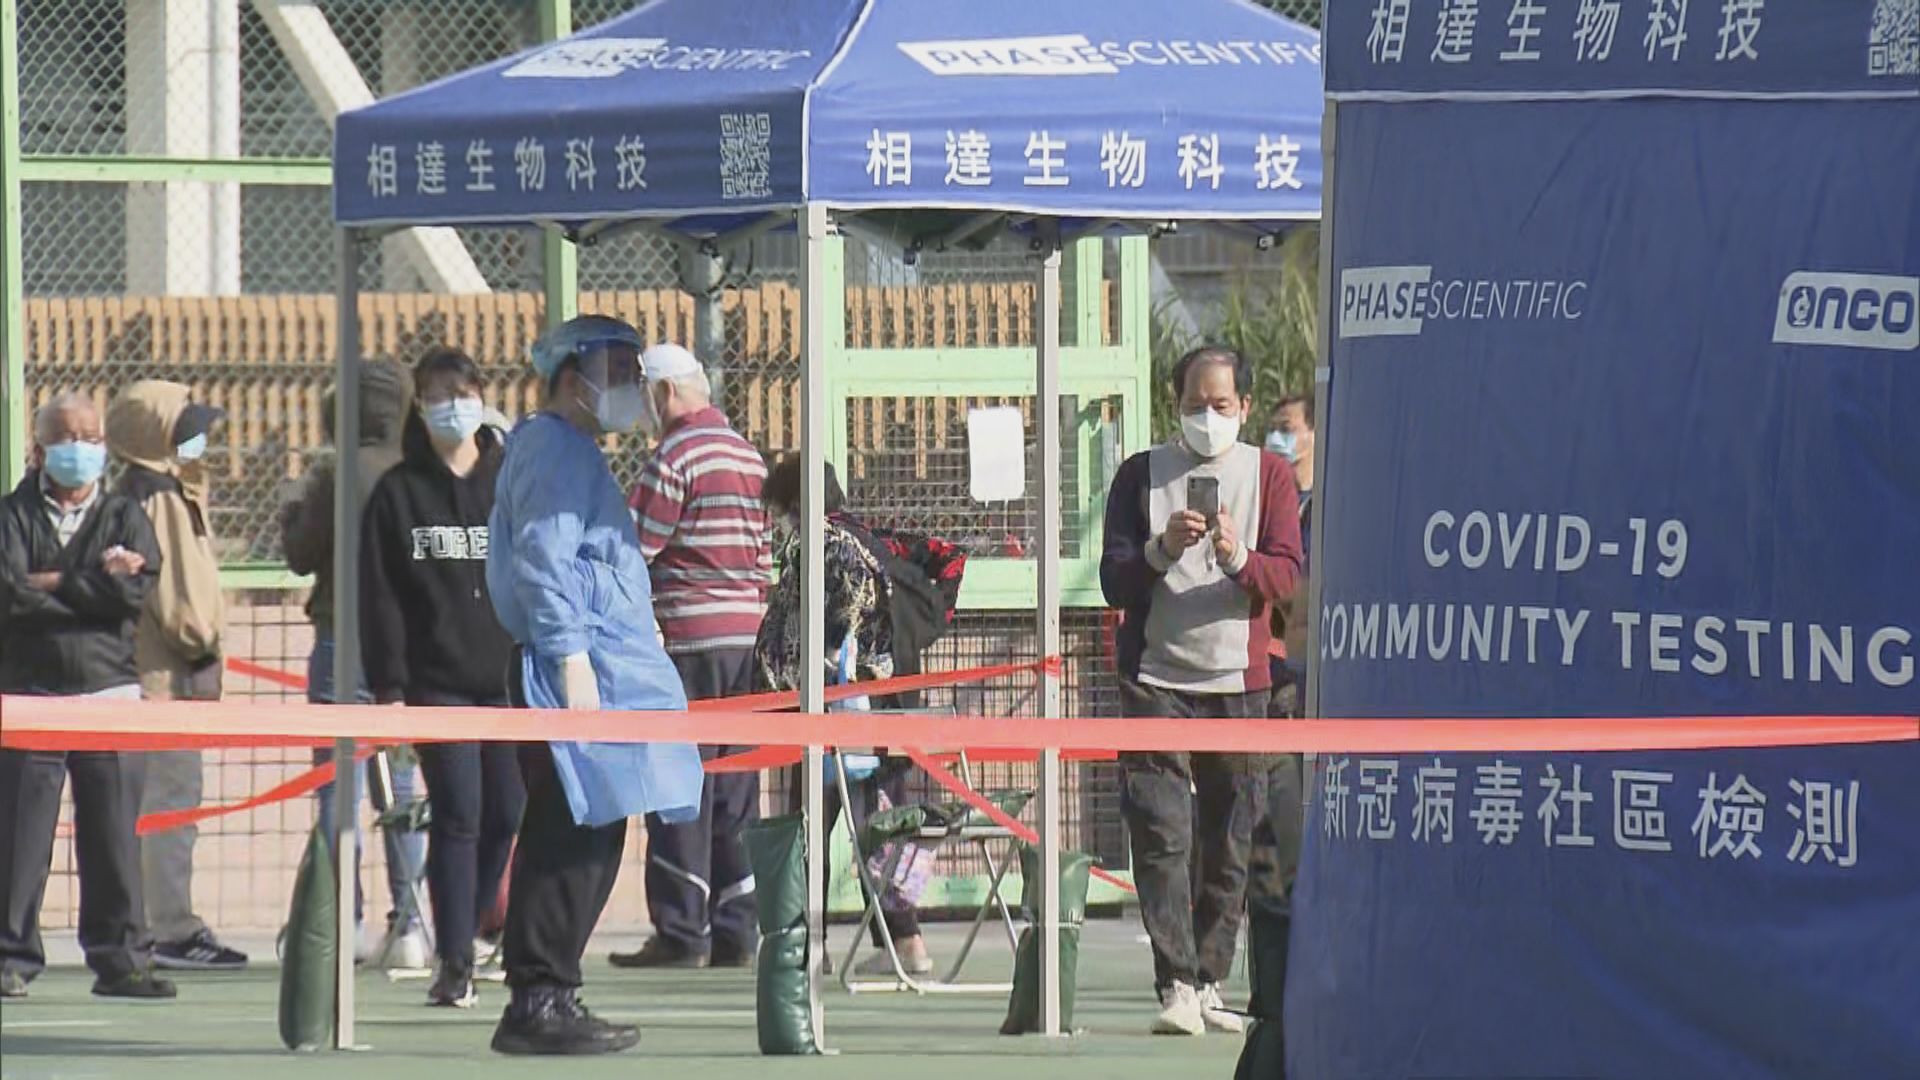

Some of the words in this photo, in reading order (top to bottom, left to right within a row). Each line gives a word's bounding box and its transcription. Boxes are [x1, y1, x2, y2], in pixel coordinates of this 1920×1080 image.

[1366, 0, 1765, 64] 相達生物科技
[366, 135, 648, 198] 相達生物科技
[866, 128, 1303, 190] 相達生物科技
[1423, 509, 1689, 578] COVID-19
[1321, 603, 1590, 666] COMMUNITY
[1612, 611, 1915, 686] TESTING
[1324, 755, 1860, 867] 新冠病毒社區檢測
